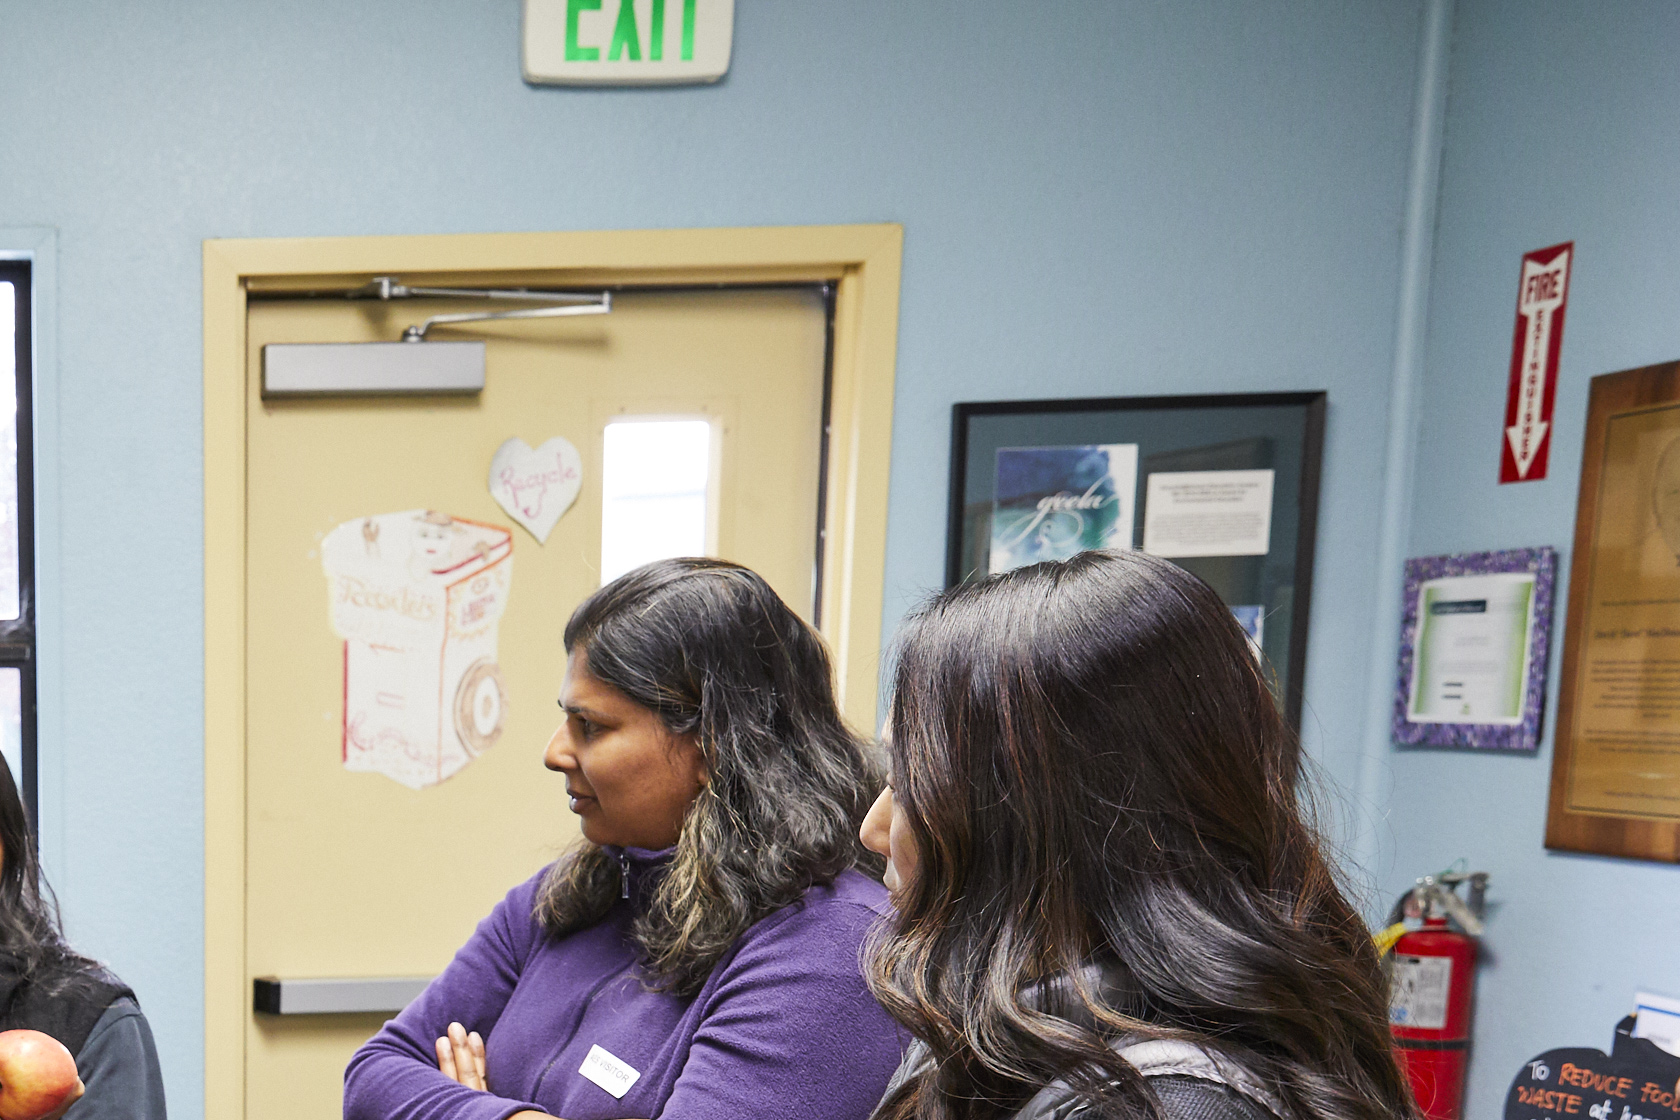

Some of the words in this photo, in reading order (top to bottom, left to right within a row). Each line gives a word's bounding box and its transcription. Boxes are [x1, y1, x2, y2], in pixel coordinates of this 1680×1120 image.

[1526, 268, 1561, 303] FIRE
[500, 452, 577, 518] Recycle
[600, 1060, 630, 1083] VISITOR
[1558, 1063, 1634, 1098] REDUCE
[1517, 1086, 1582, 1114] WASTE
